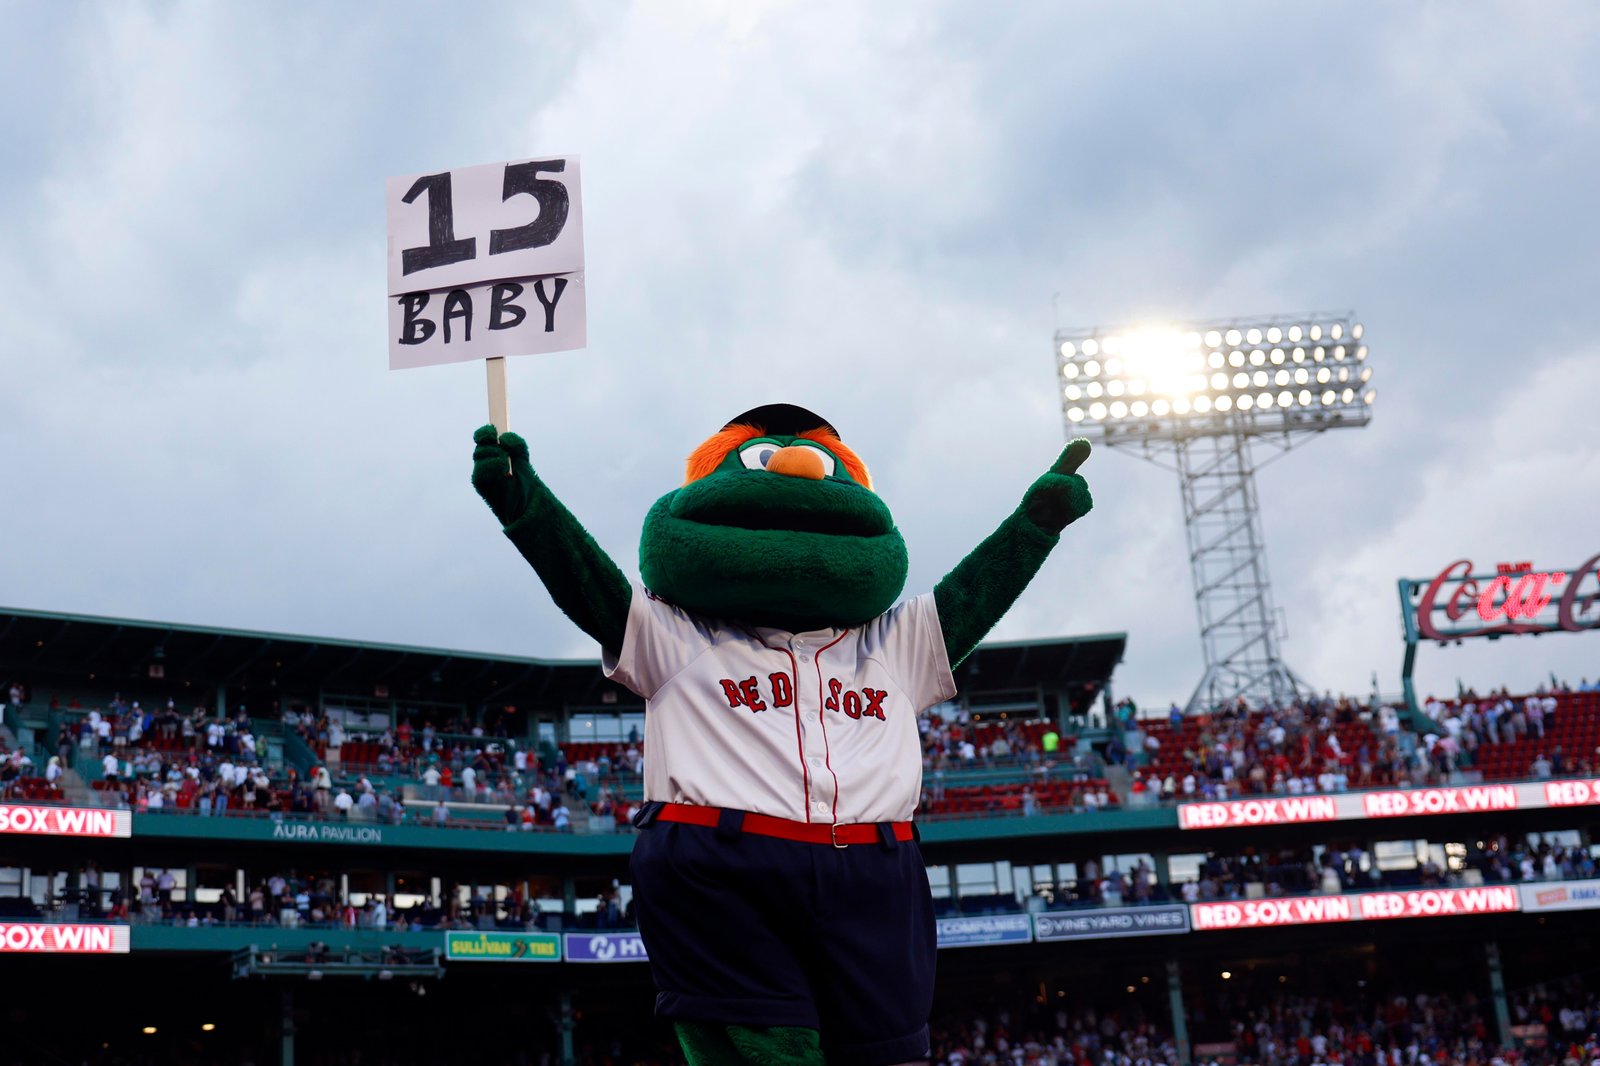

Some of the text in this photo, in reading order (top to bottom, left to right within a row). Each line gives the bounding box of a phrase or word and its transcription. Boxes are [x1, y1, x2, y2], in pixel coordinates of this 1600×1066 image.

[401, 159, 569, 276] 15
[398, 278, 568, 345] BABY
[719, 672, 888, 721] RED SOX
[1365, 785, 1516, 816] RED SOX WIN
[1547, 782, 1589, 806] RED
[55, 810, 112, 834] WIN
[1185, 796, 1335, 827] RED SOX WIN
[321, 826, 381, 843] PAVILION
[1198, 896, 1350, 928] RED SOX WIN
[1361, 894, 1404, 918] RED
[1407, 890, 1457, 915] SOX
[1459, 887, 1514, 911] WIN
[53, 926, 110, 951] WIN
[452, 934, 555, 955] SULLIVAN TIRE
